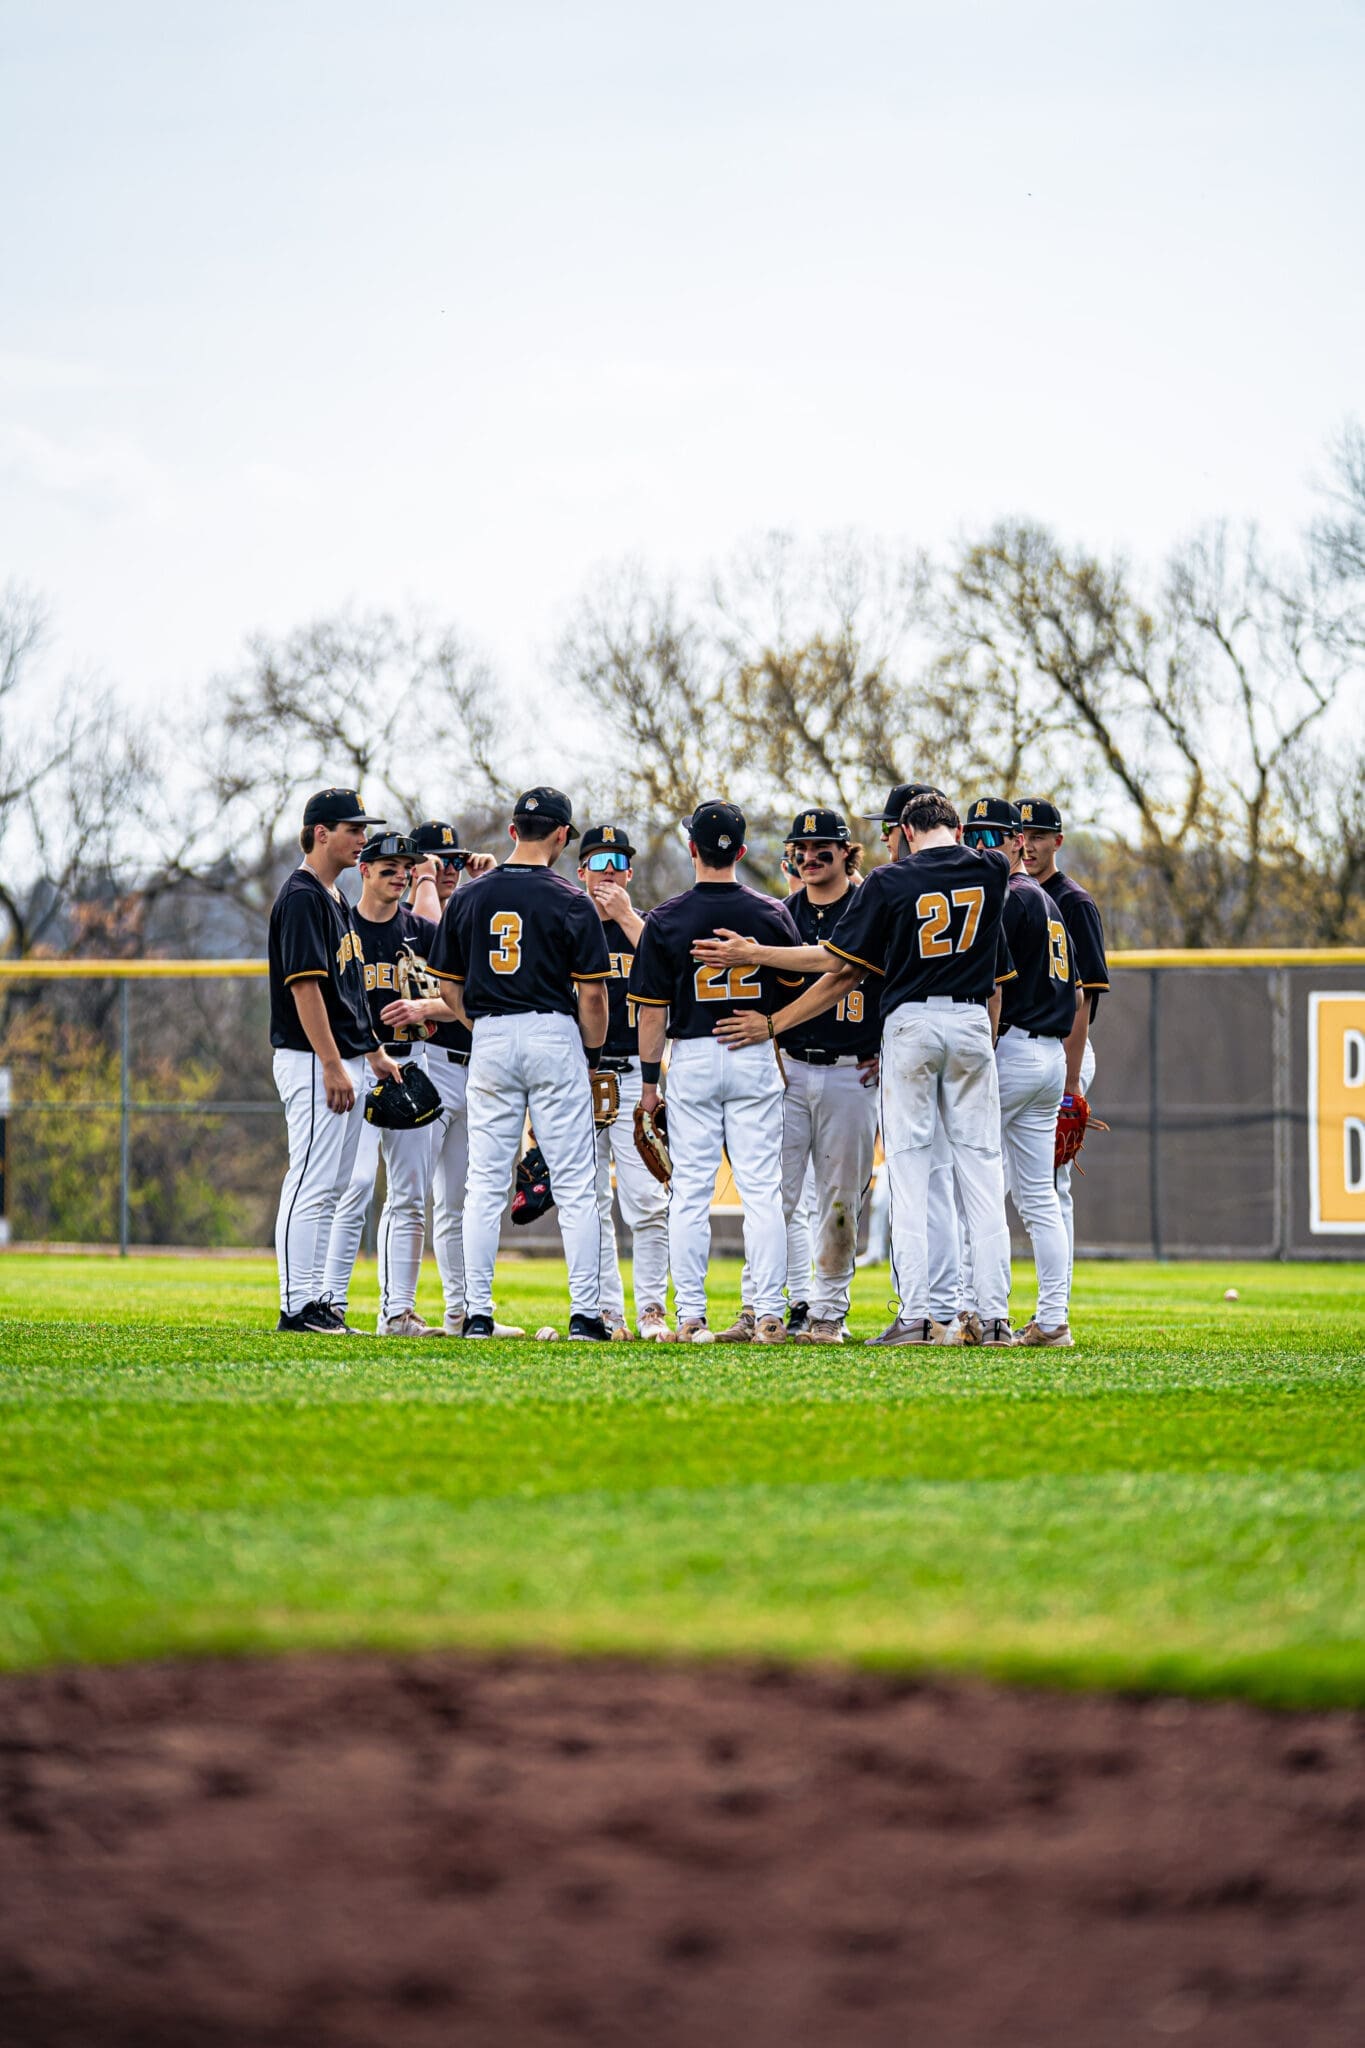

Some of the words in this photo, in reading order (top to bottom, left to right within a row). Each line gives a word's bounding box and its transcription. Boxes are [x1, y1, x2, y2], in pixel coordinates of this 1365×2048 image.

[489, 911, 523, 975] 3
[916, 886, 984, 958] 27
[836, 991, 864, 1022] 19
